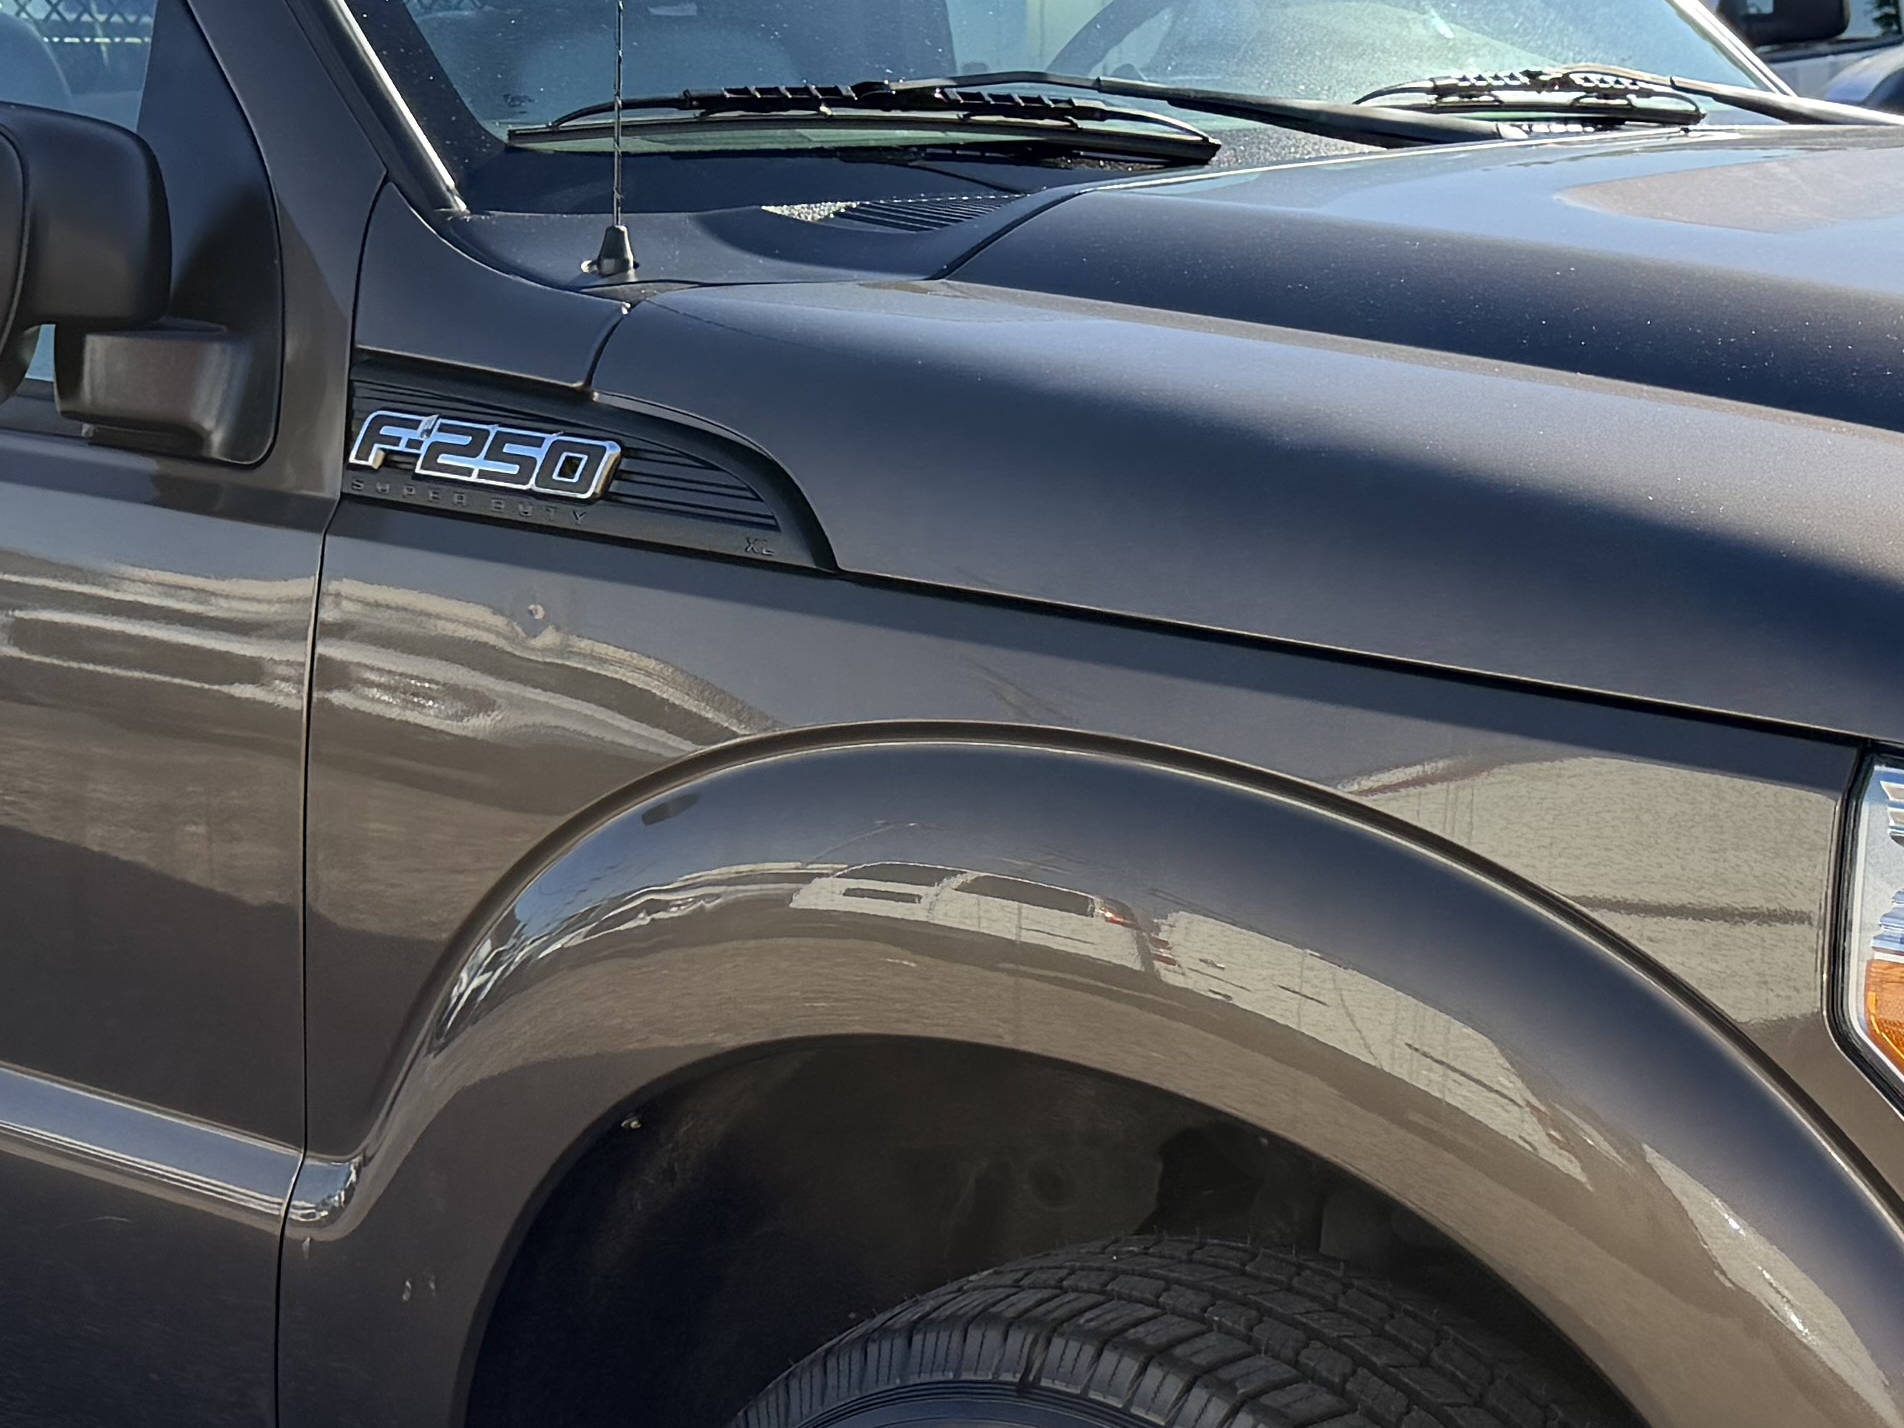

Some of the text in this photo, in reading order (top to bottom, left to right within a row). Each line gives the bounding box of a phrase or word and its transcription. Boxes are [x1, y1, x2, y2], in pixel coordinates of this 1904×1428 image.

[349, 409, 622, 500] F-250
[350, 479, 588, 526] SUPER DUTY
[743, 535, 777, 556] XL
